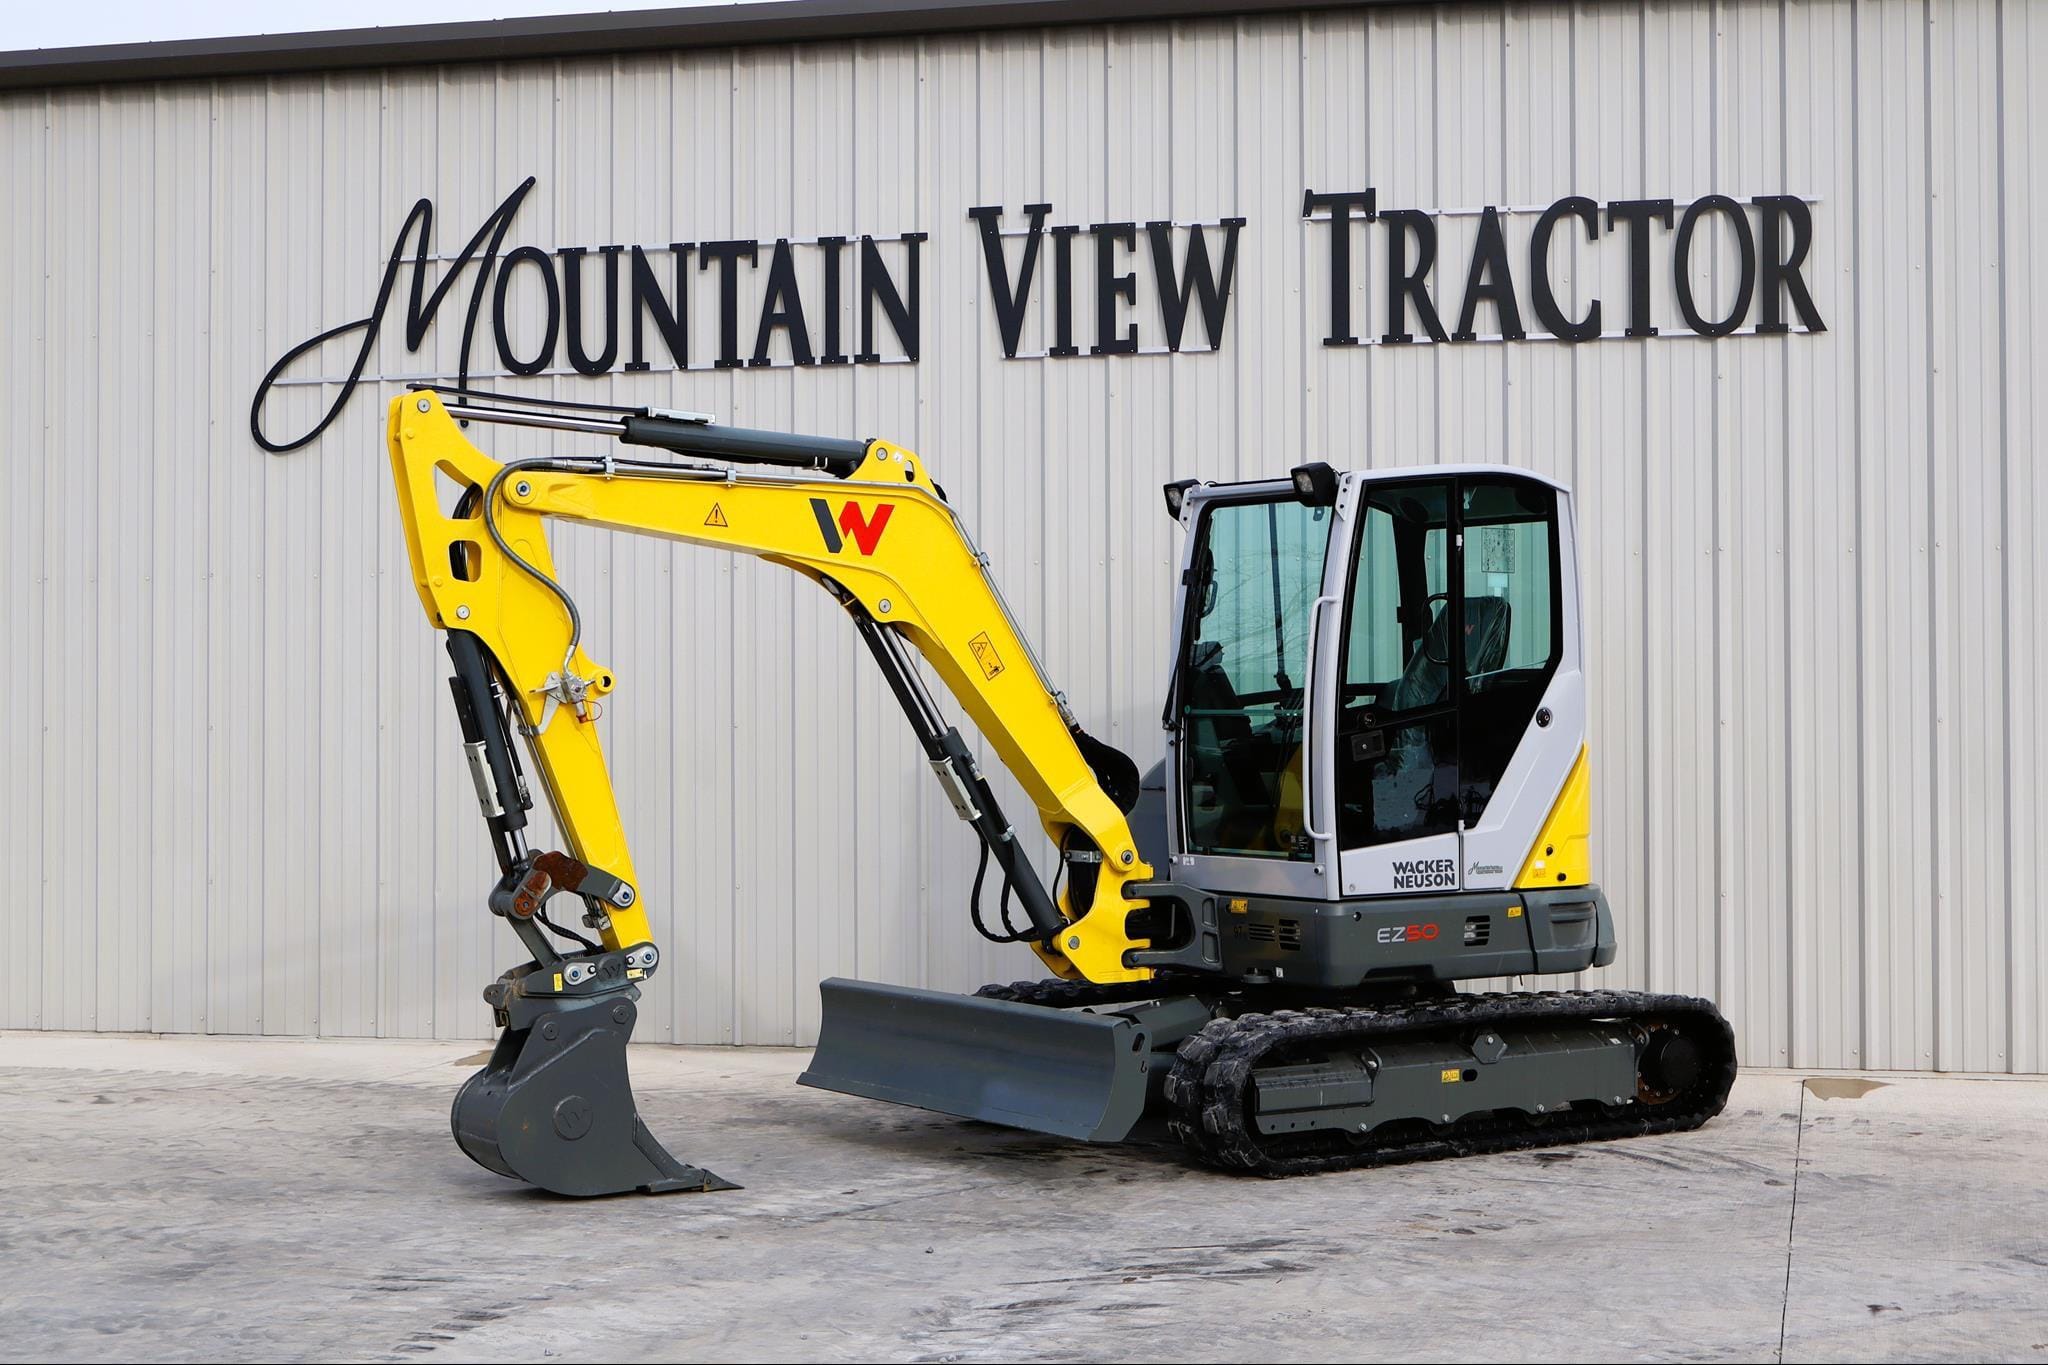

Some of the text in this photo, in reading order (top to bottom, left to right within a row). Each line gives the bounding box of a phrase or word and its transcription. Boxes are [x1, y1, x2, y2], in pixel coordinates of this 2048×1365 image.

[251, 175, 1828, 453] MOUNTAIN VIEW TRACTOR
[1392, 859, 1455, 875] WACKER
[1393, 873, 1456, 889] NEUSON
[1377, 923, 1440, 943] EZ50
